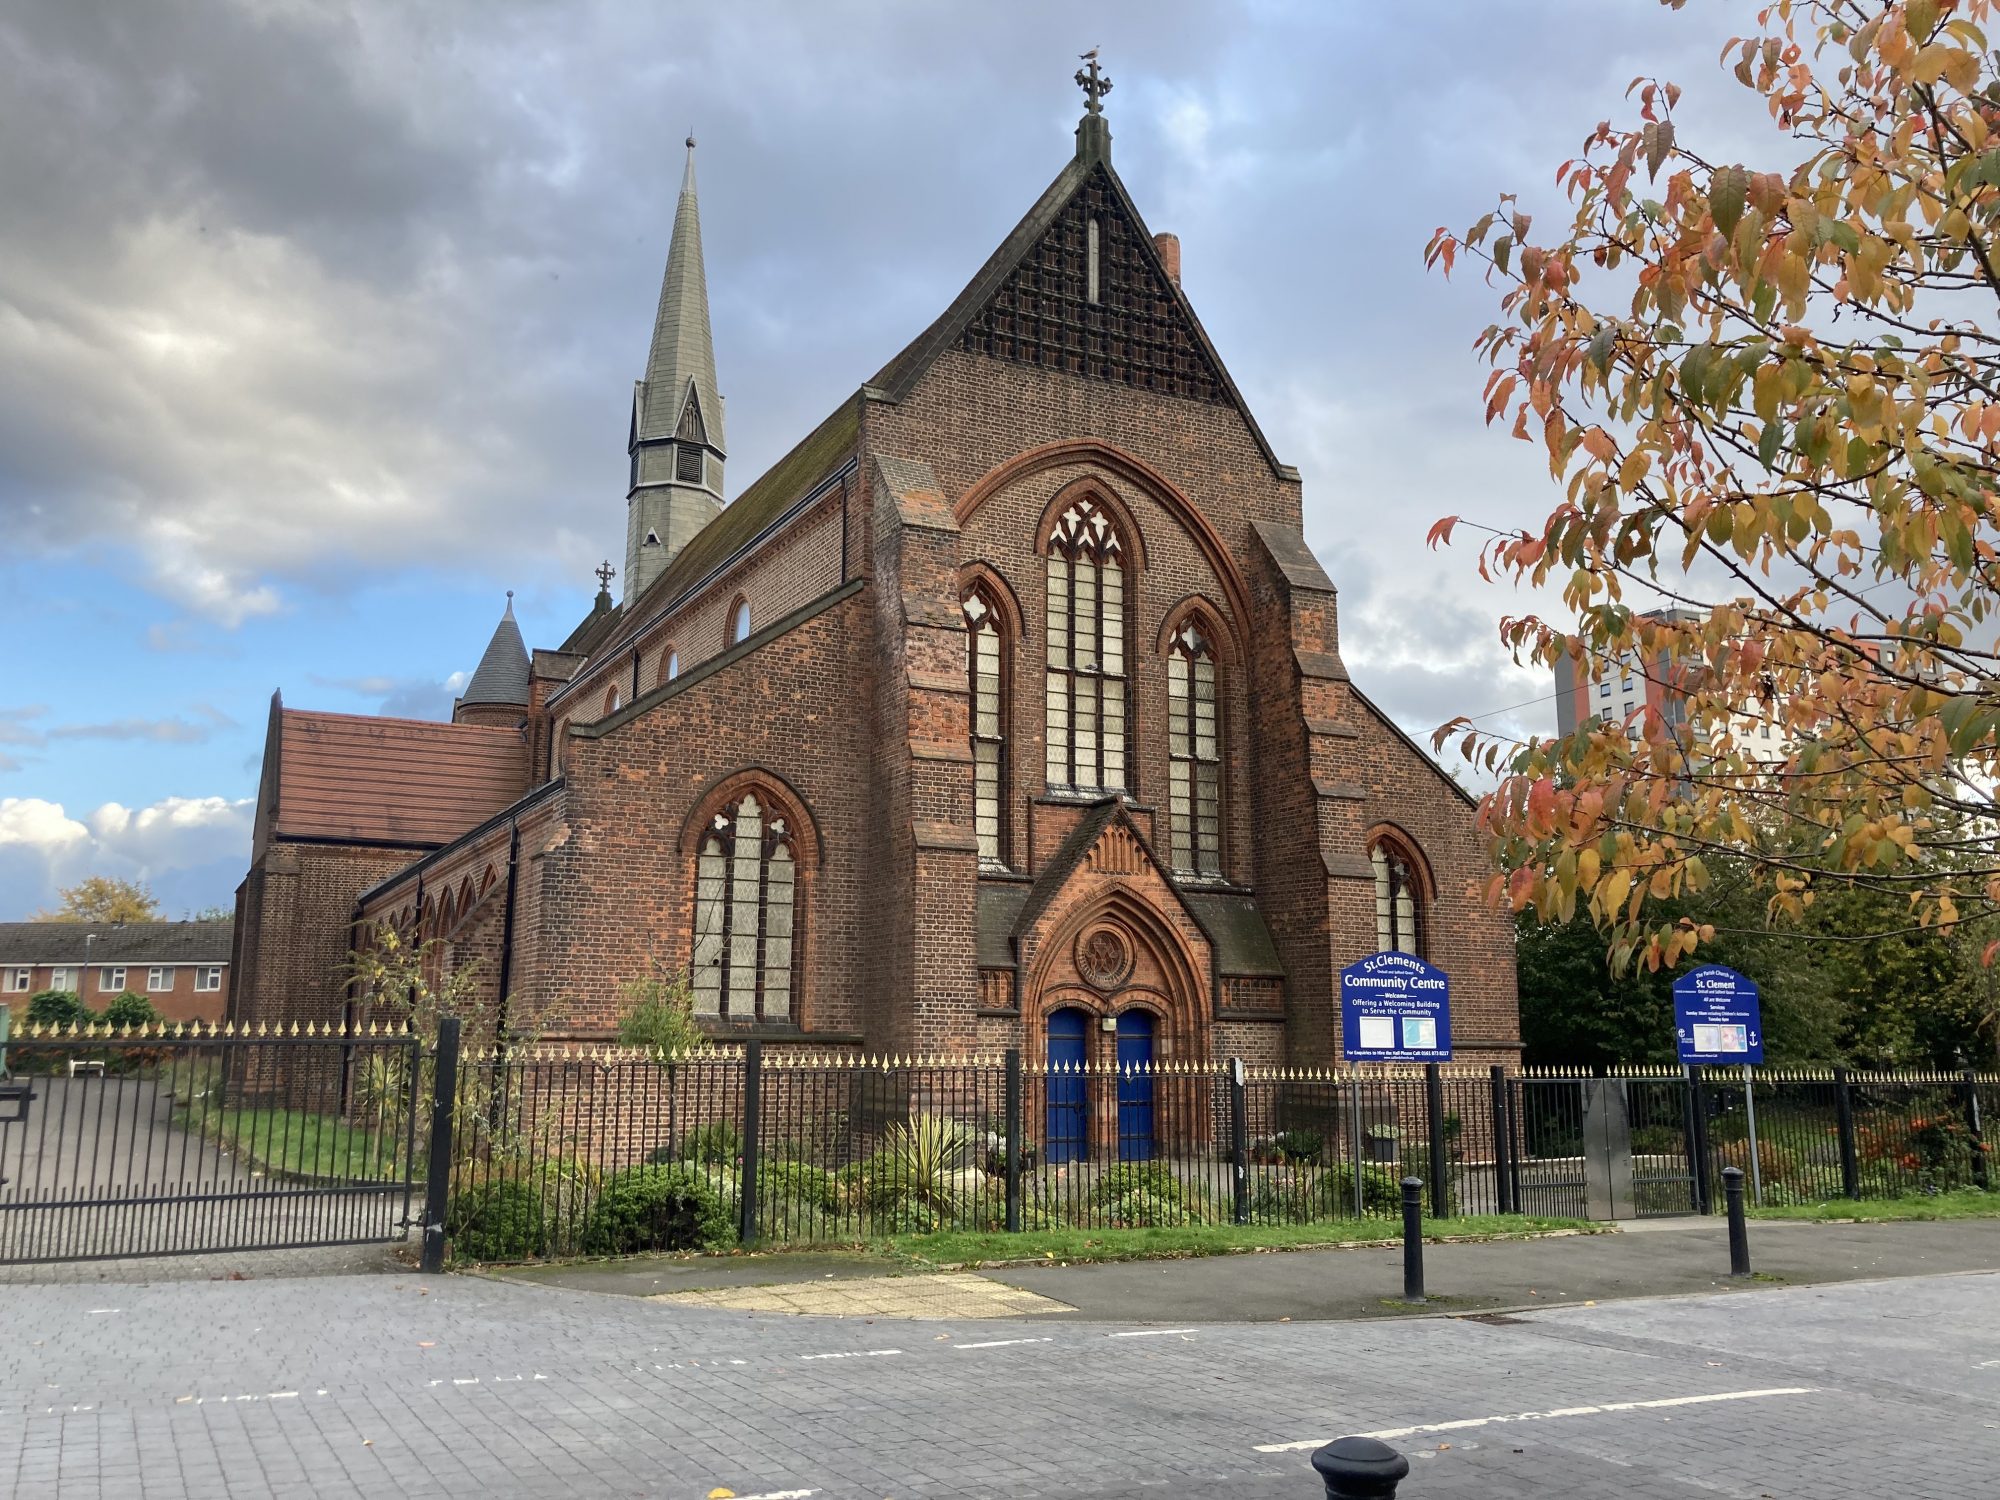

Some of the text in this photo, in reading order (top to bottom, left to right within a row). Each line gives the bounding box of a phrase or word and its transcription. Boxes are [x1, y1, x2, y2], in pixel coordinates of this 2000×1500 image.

[1364, 955, 1425, 974] St.Clements
[1716, 970, 1729, 978] Church
[1345, 975, 1445, 990] Community Centre
[1696, 980, 1735, 989] St. Clement
[1352, 999, 1377, 1007] Offering
[1384, 1000, 1415, 1008] Welcoming
[1417, 1001, 1440, 1009] Building
